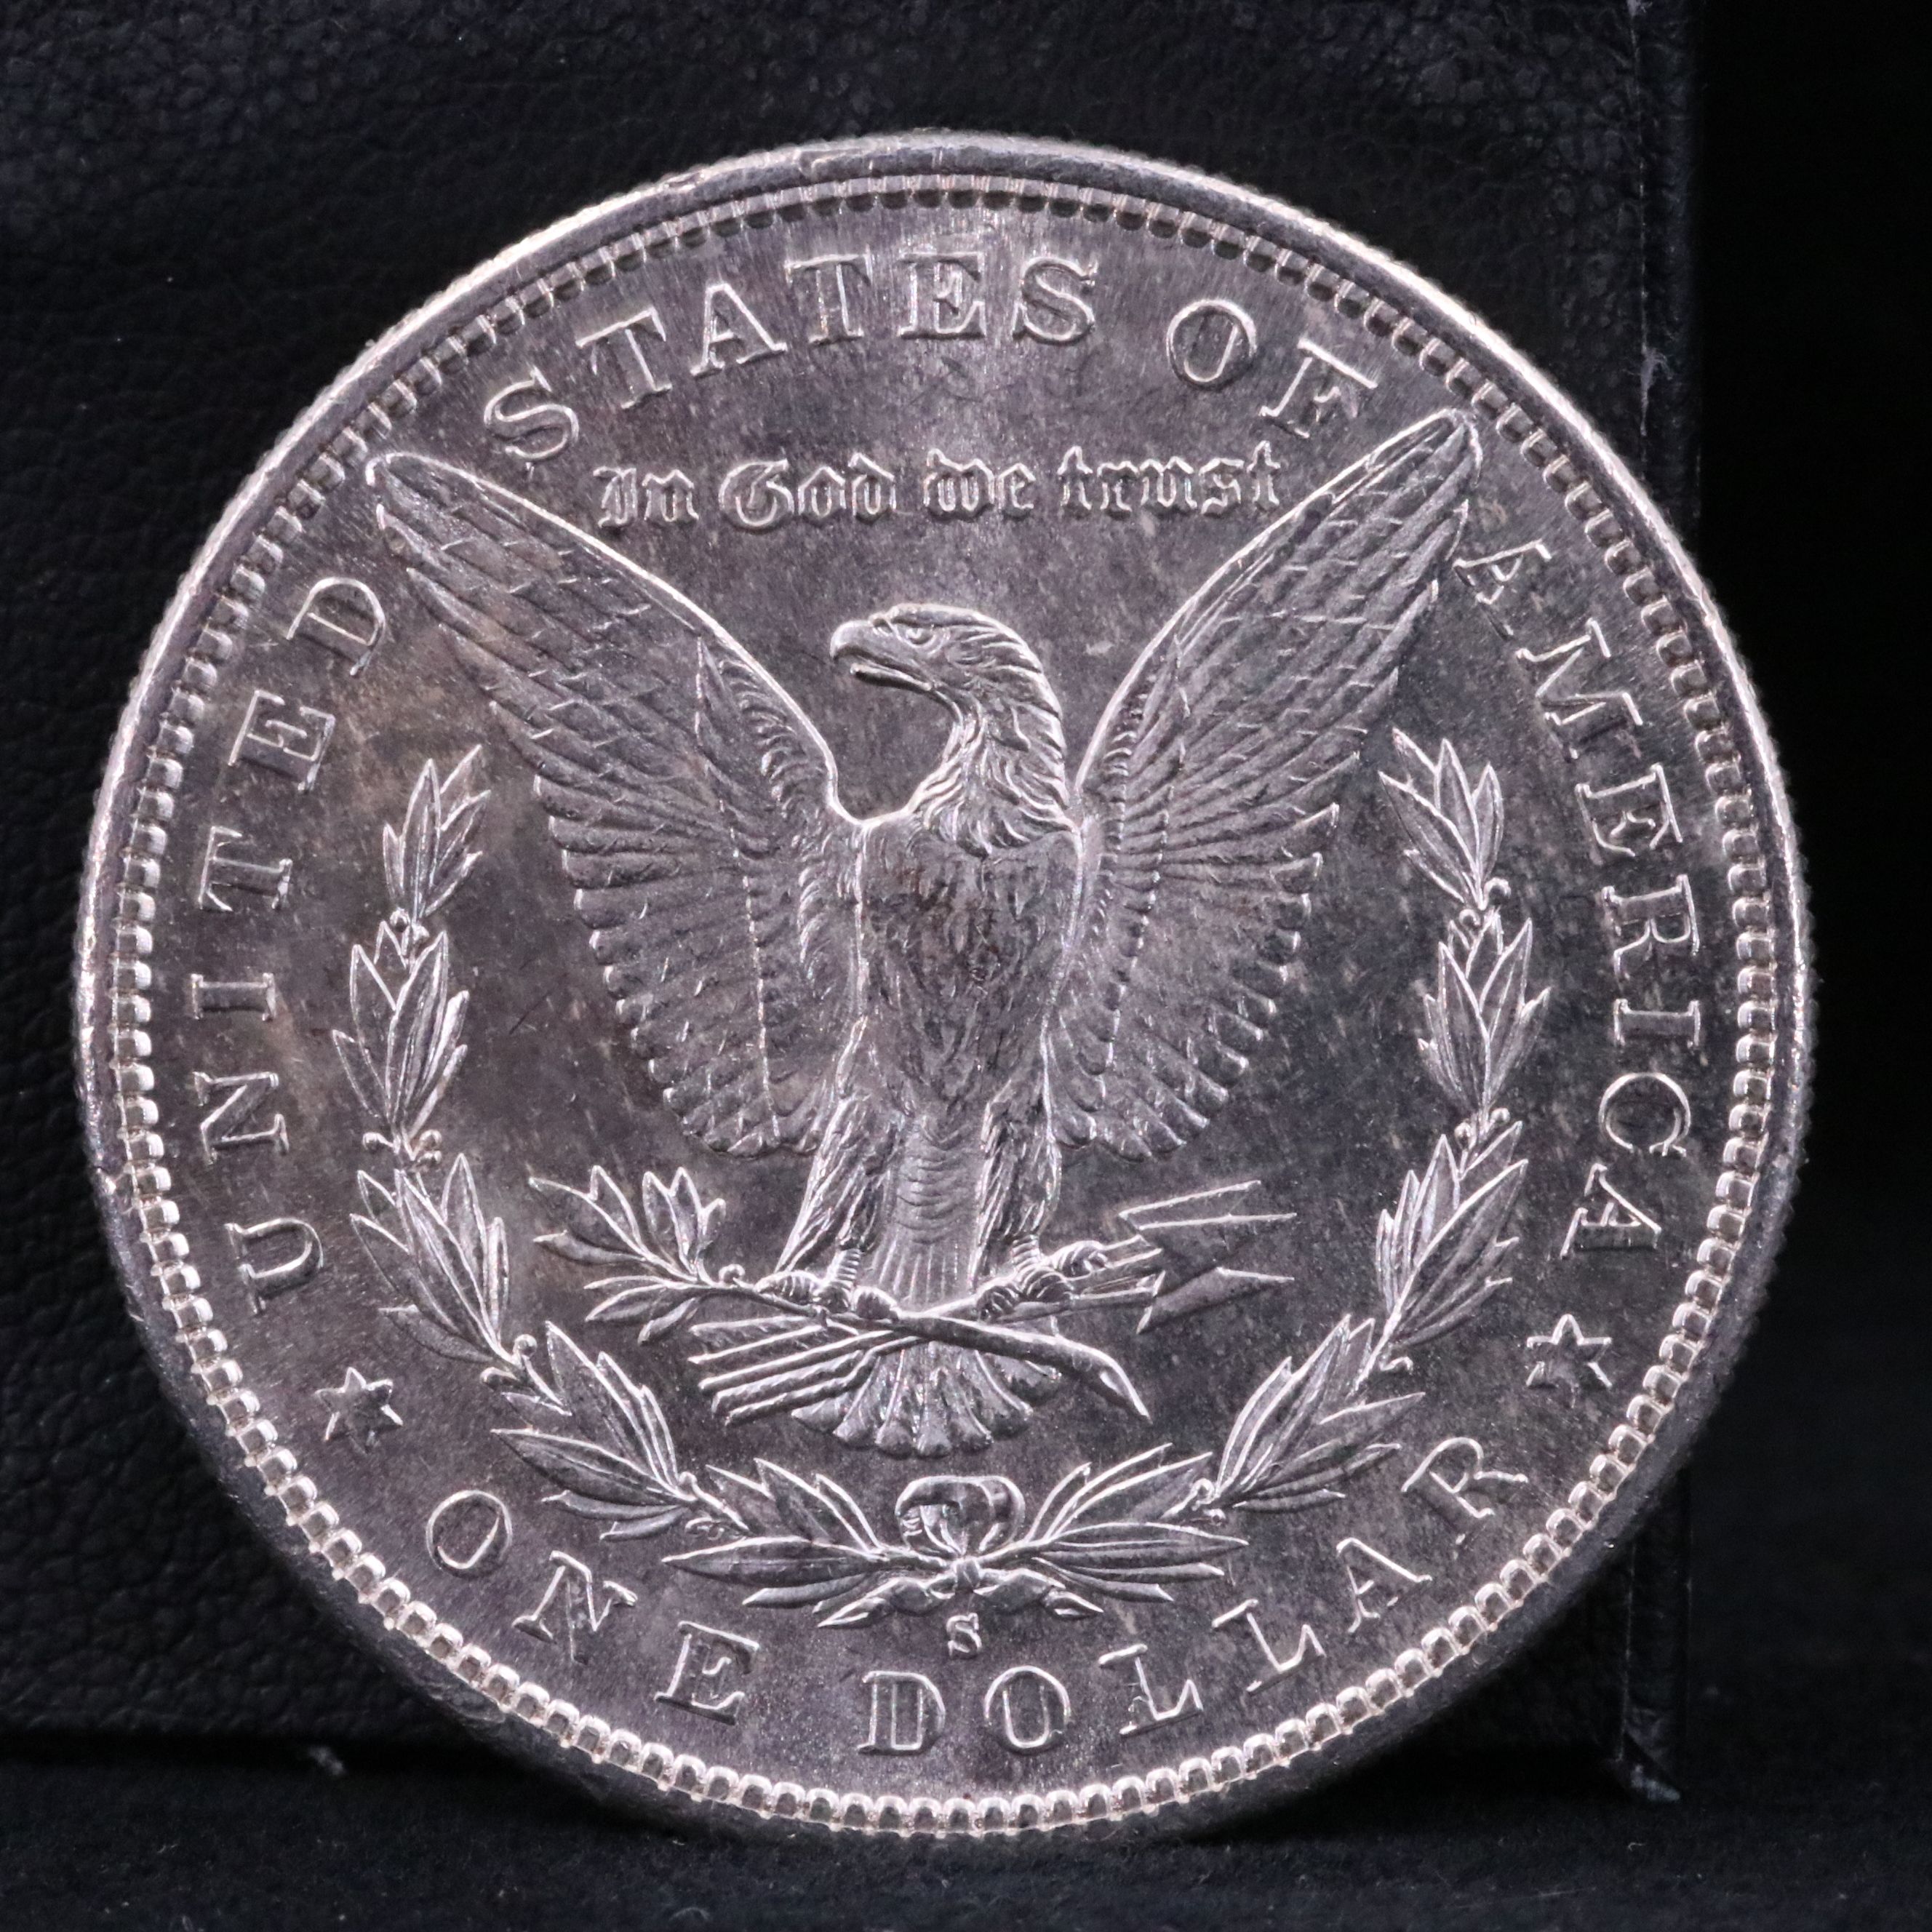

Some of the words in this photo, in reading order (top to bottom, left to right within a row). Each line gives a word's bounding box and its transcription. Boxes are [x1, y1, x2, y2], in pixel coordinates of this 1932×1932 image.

[593, 464, 699, 530] In
[716, 452, 900, 530] God
[924, 452, 1037, 515] we
[1056, 442, 1282, 514] trust
[191, 575, 388, 1312] UNITED
[482, 248, 1099, 463] STATES
[1165, 297, 1378, 439] OF
[1453, 539, 1702, 1258] AMERICA
[425, 1488, 762, 1721] ONE
[860, 1435, 1529, 1752] DOLLAR
[946, 1613, 983, 1655] S
